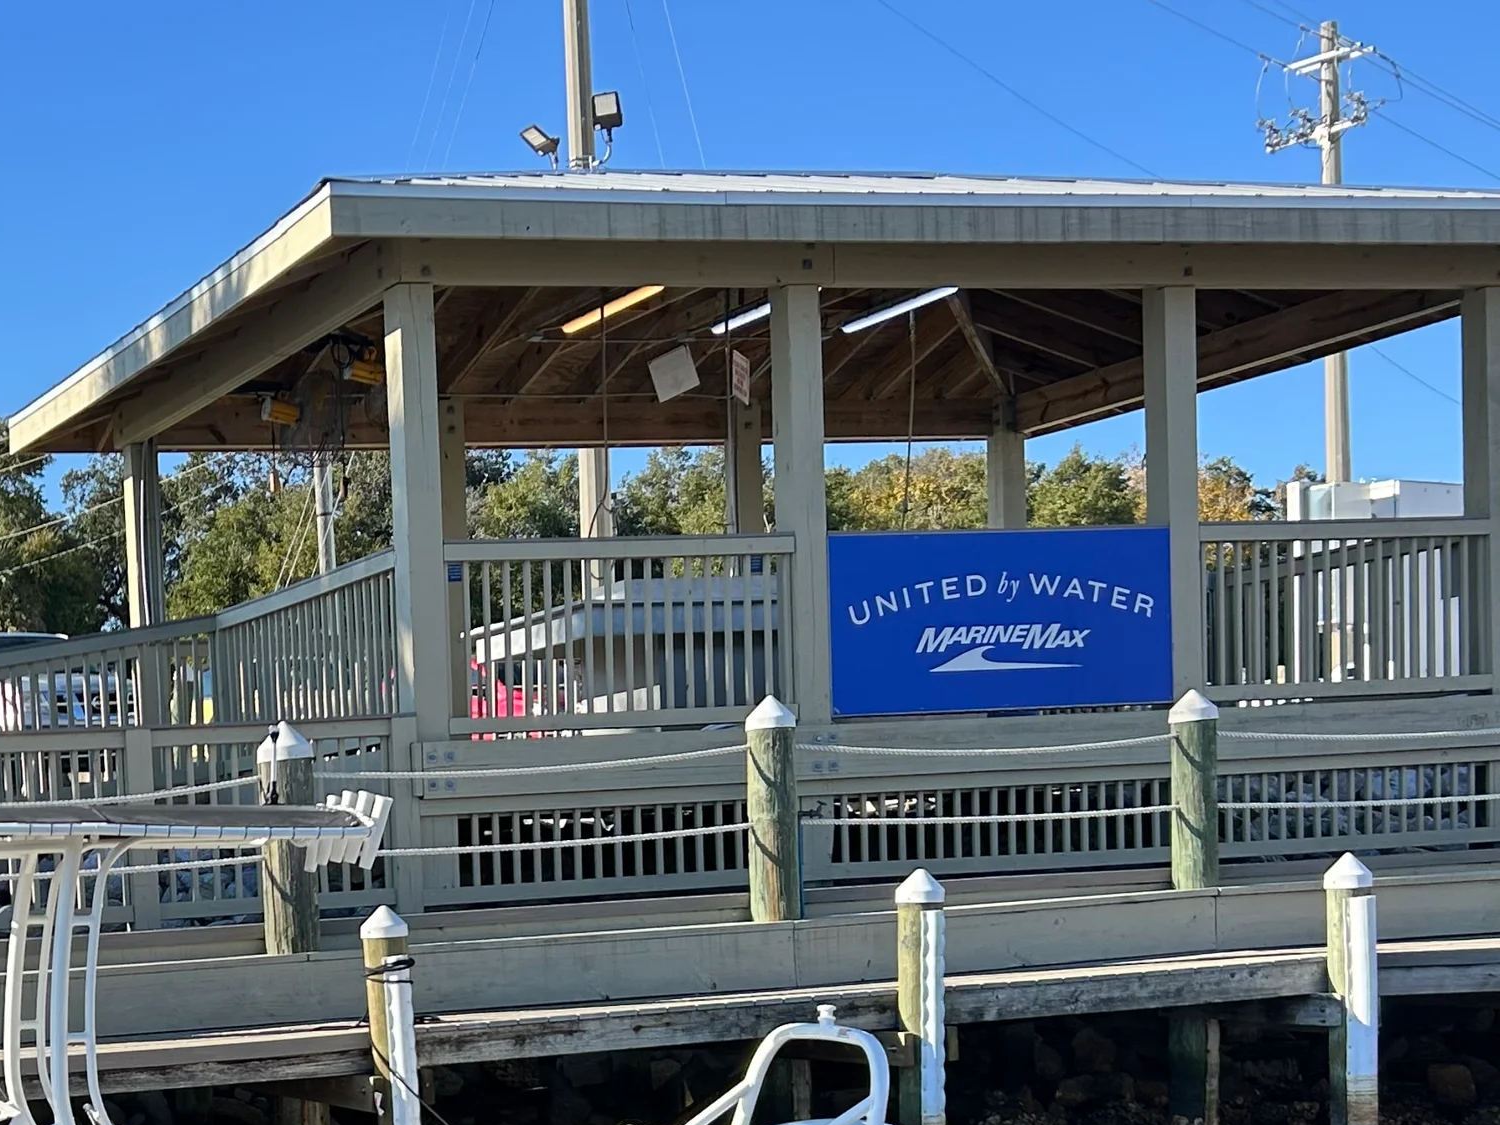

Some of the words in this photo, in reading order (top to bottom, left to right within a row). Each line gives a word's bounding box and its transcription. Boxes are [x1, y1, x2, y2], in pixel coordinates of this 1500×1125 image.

[848, 574, 988, 625] UNITED
[997, 571, 1020, 603] by
[1028, 573, 1155, 618] WATER
